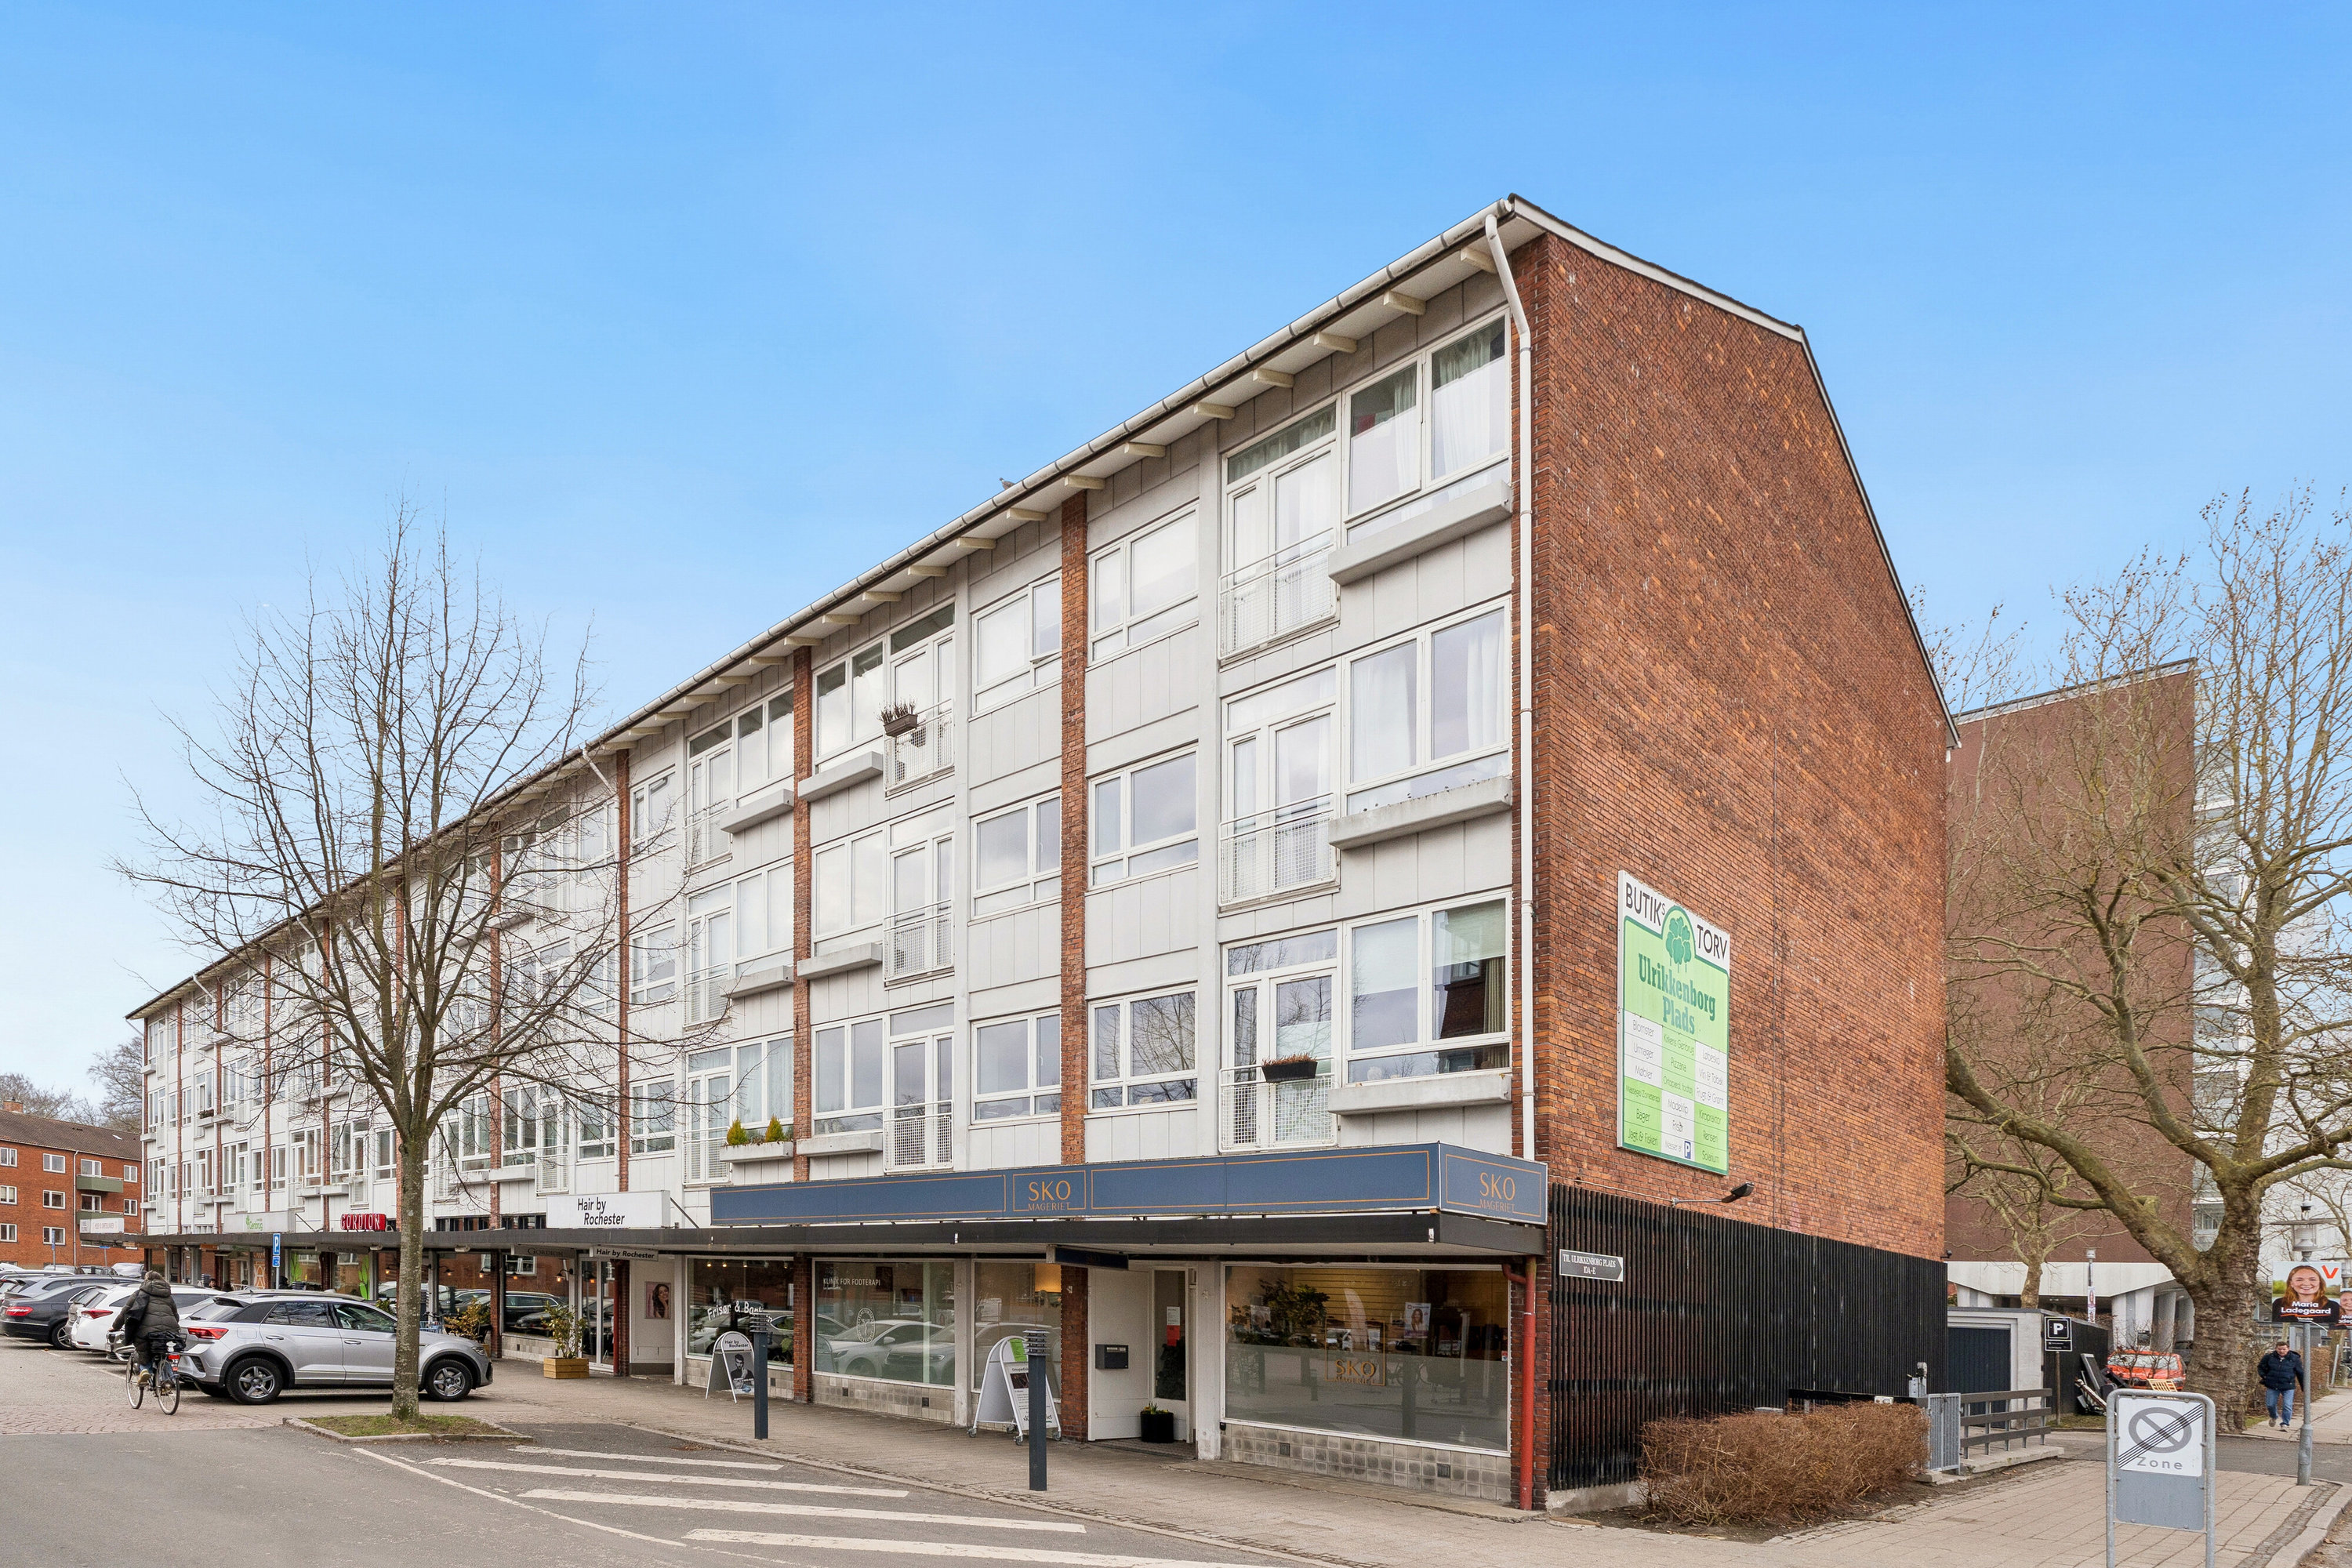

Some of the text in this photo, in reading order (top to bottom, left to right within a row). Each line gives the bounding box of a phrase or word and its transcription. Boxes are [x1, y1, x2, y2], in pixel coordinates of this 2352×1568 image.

[1697, 924, 1727, 960] TORV
[1639, 953, 1716, 1022] Ulrikkenborg
[1663, 996, 1695, 1035] Plads
[1632, 1019, 1654, 1037] Blomster
[1633, 1042, 1653, 1060] Urmager
[1635, 1065, 1653, 1080] Møbler
[1696, 1087, 1706, 1102] Frugt
[1636, 1108, 1650, 1123] Bager
[1628, 1128, 1639, 1142] Jagt
[1701, 1150, 1720, 1163] Solarium
[1028, 1180, 1071, 1202] SKO
[1480, 1172, 1515, 1201] SKO
[577, 1196, 607, 1214] Hair by
[1028, 1202, 1071, 1211] MAGERIET
[1479, 1199, 1515, 1213] MAGERIET
[340, 1214, 380, 1230] GORDION
[583, 1212, 626, 1225] Rochester
[622, 1250, 655, 1259] Rochester
[1563, 1254, 1616, 1268] TIL ULRIKKENBORG PLADS
[2321, 1265, 2339, 1279] V
[707, 1304, 731, 1321] Frisør
[734, 1300, 741, 1312] &
[2053, 1323, 2063, 1335] P
[1335, 1359, 1376, 1377] SKO
[2136, 1456, 2183, 1470] Zone
